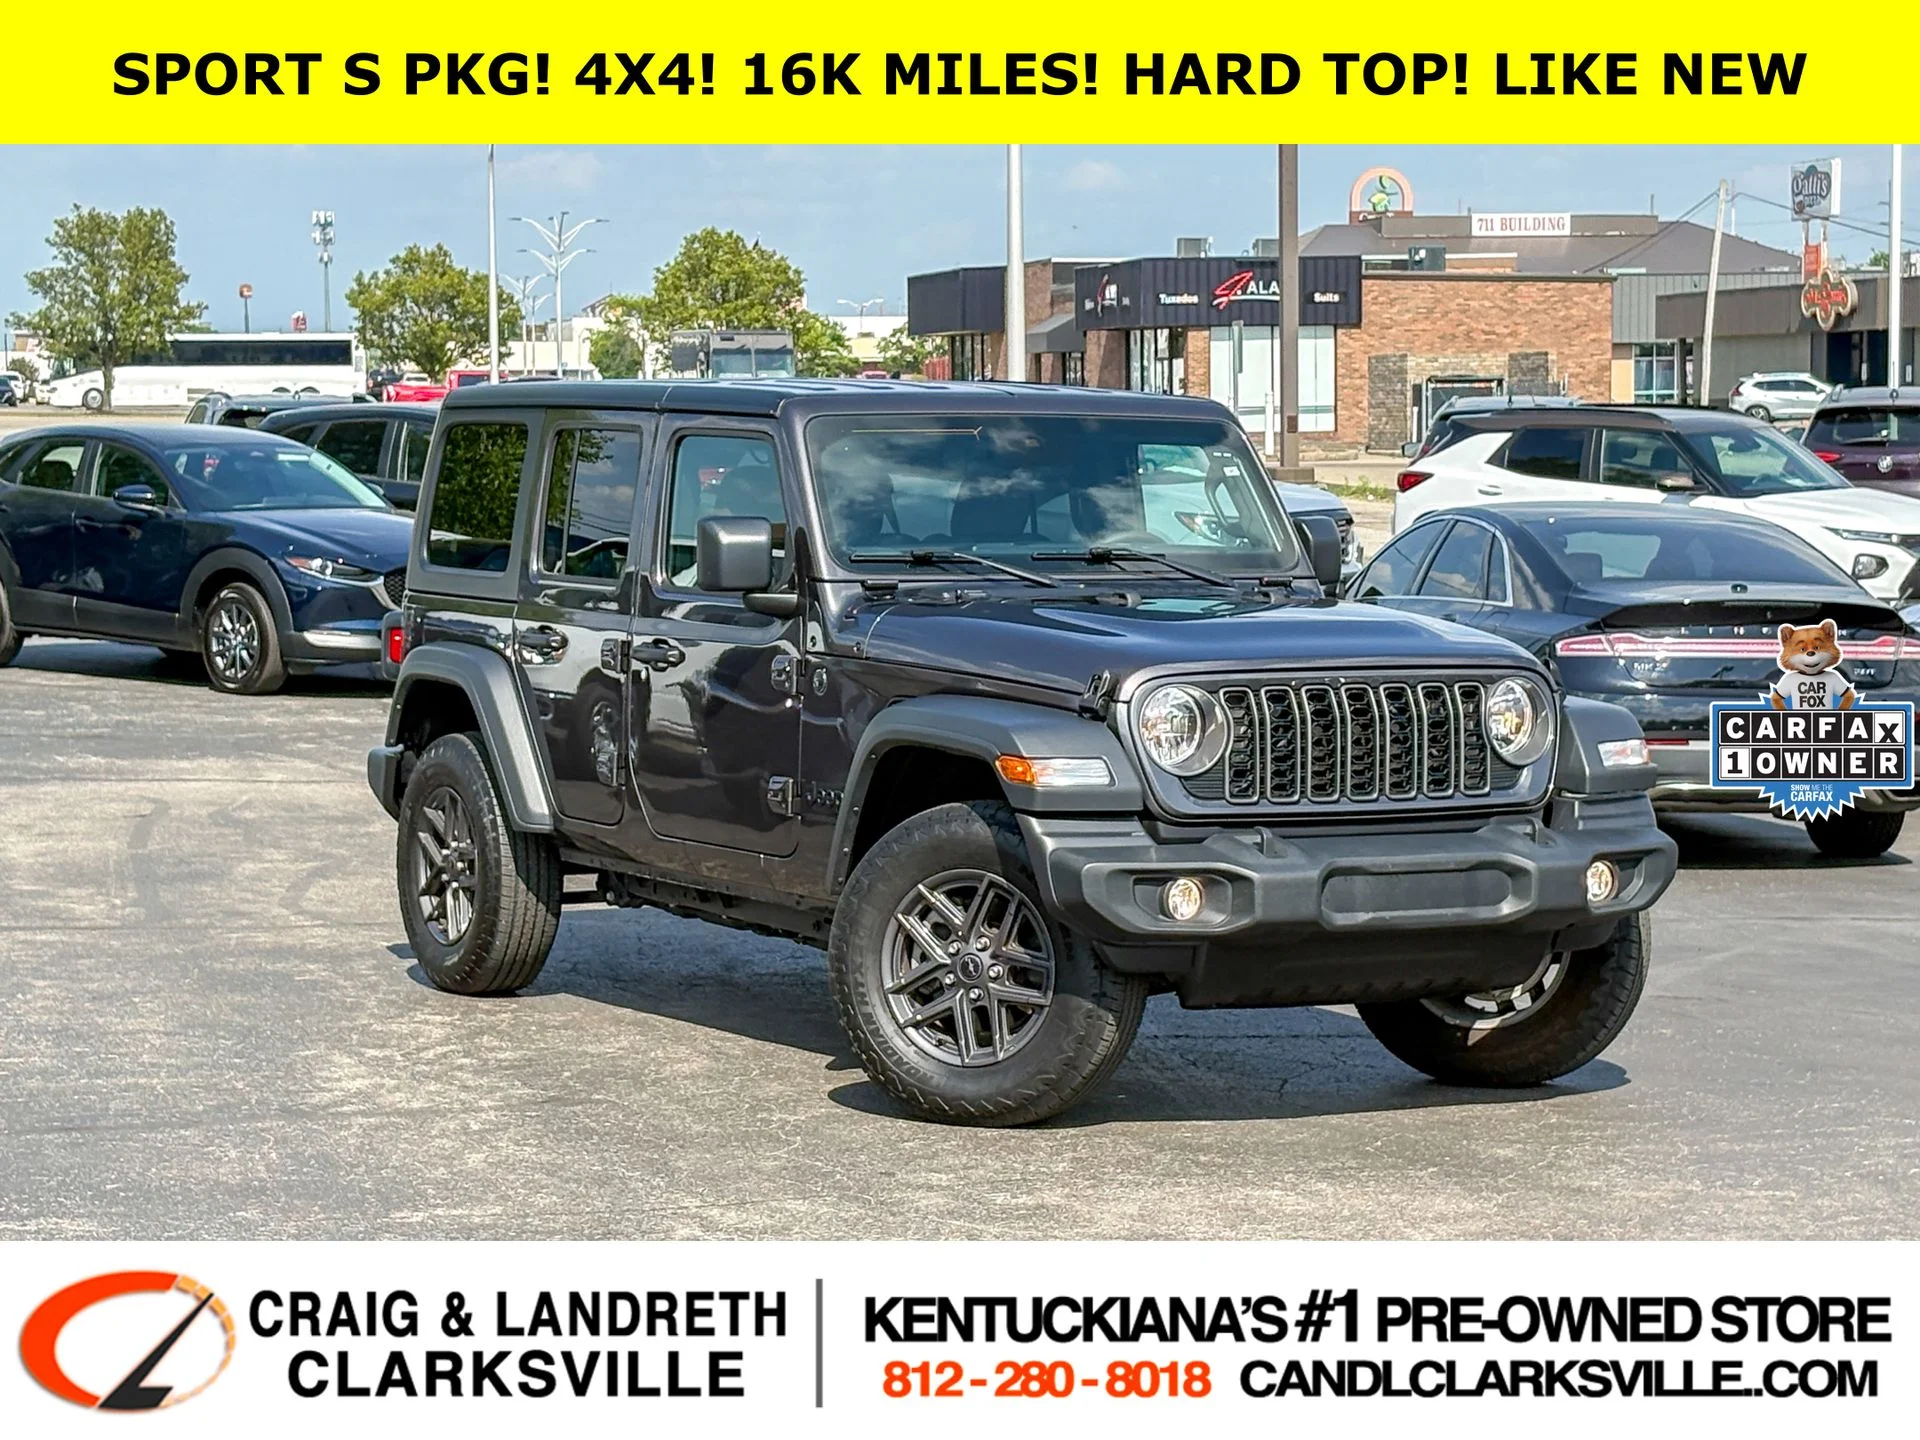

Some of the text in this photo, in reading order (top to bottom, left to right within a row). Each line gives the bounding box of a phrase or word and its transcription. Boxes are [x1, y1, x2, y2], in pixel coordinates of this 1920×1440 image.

[1477, 216, 1566, 232] 711 BUILDING
[1313, 292, 1340, 303] Suits
